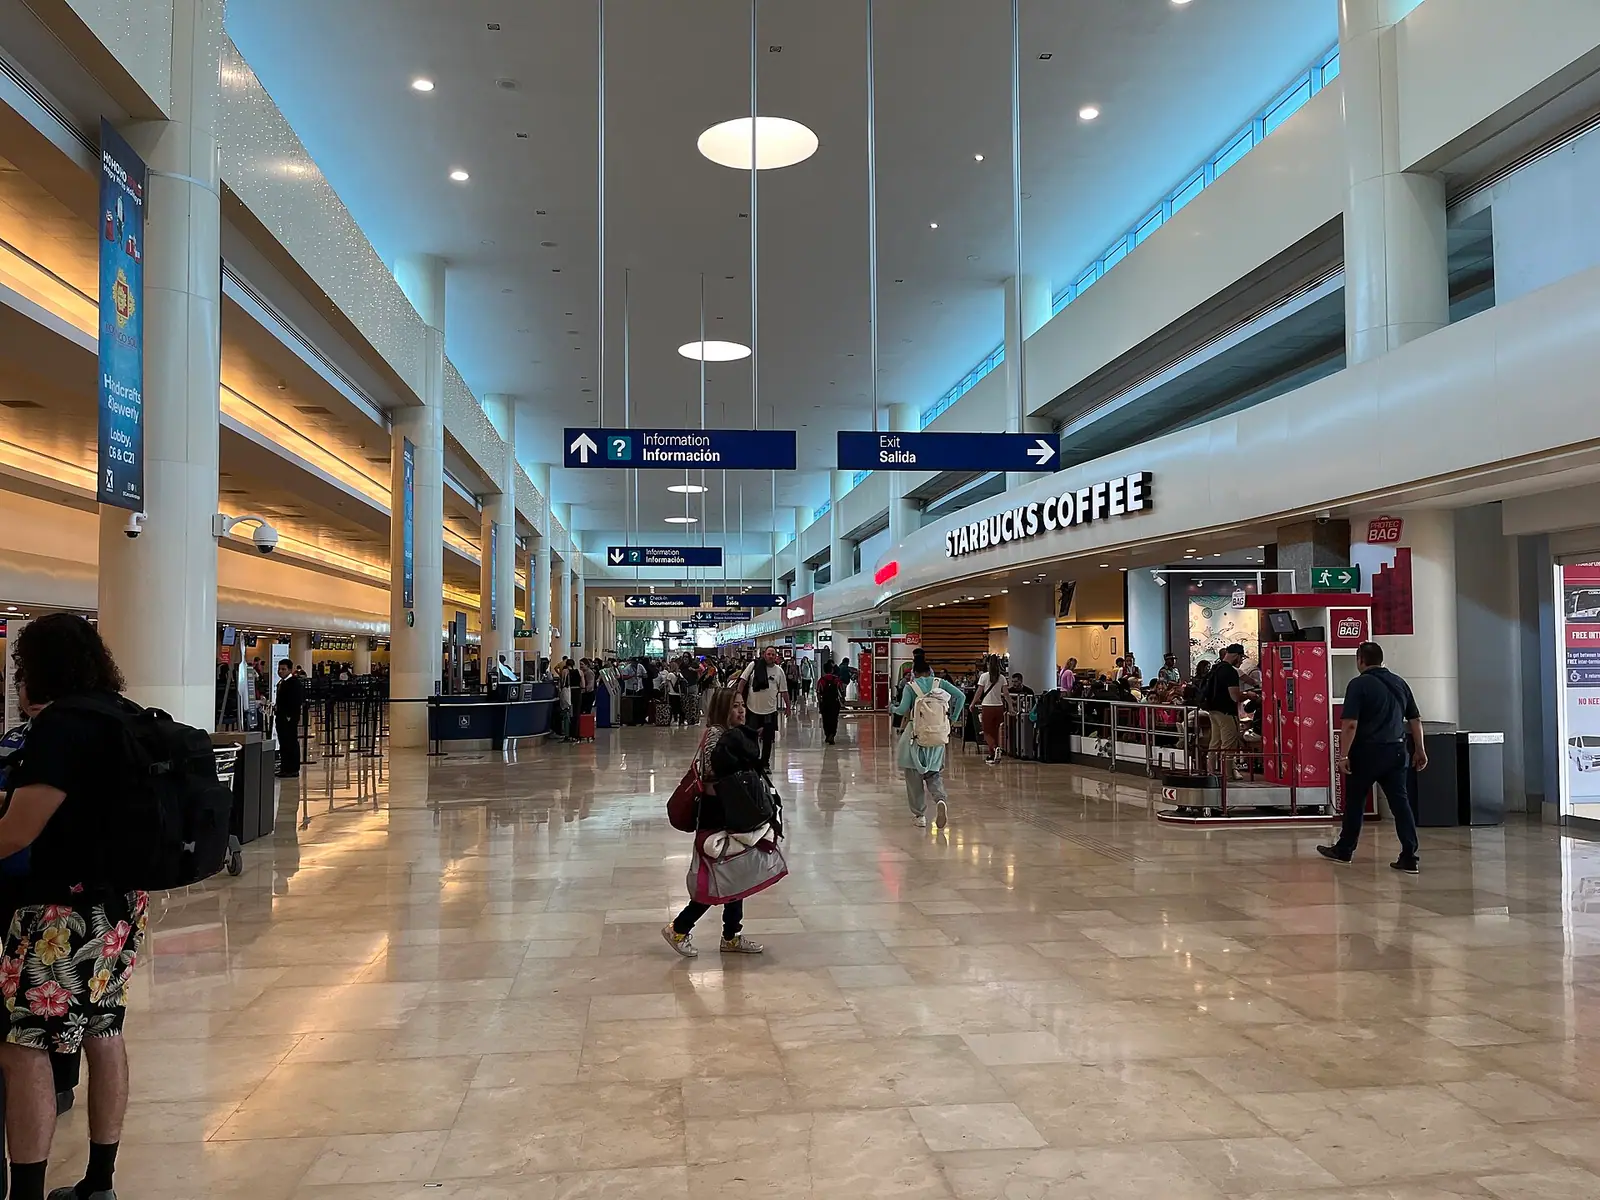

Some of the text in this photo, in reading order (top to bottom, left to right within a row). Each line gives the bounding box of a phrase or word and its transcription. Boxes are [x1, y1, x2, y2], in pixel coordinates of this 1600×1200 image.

[111, 427, 133, 448] Lobby,
[643, 432, 710, 446] Information
[880, 435, 900, 448] Exit
[643, 447, 720, 462] Información
[879, 450, 916, 463] Salida
[945, 472, 1146, 558] STARBUCKS COFFEE
[1370, 521, 1399, 529] PROTEC
[1369, 528, 1398, 541] BAG
[645, 548, 680, 556] Information
[645, 556, 685, 564] Información
[1233, 597, 1244, 606] BAG
[1340, 626, 1359, 636] BAG
